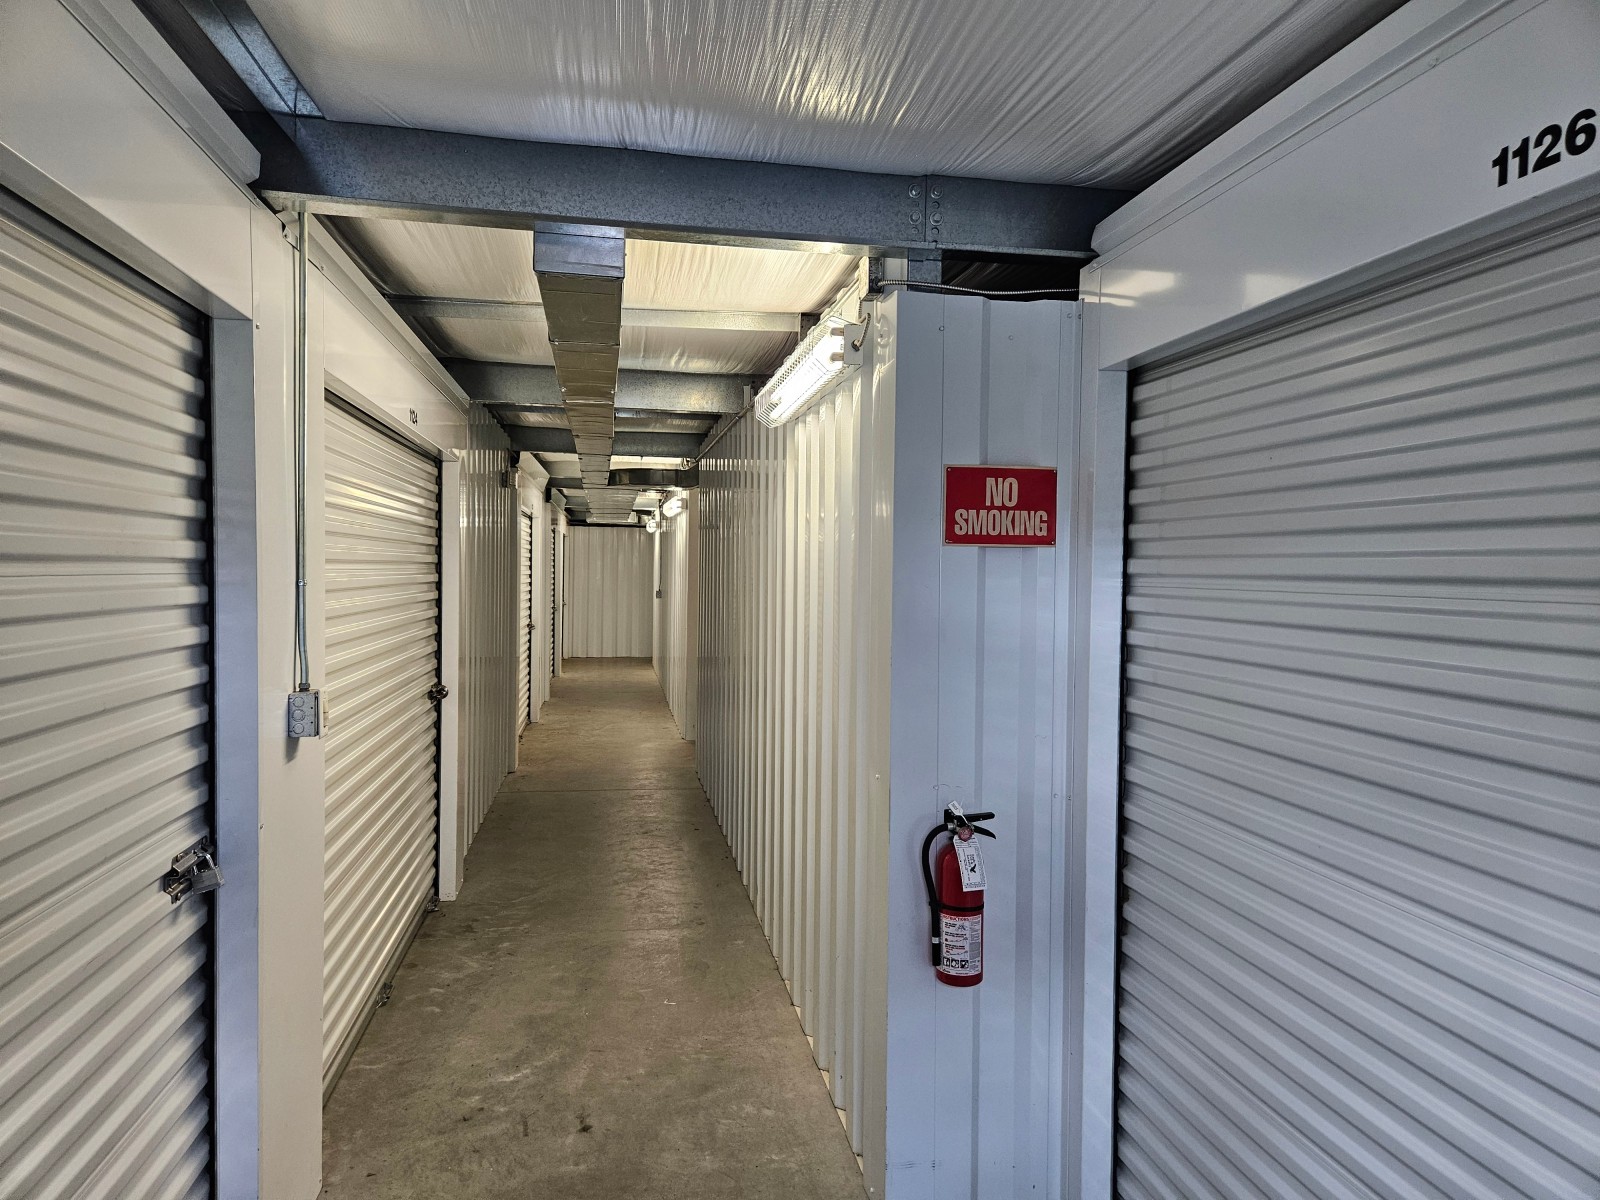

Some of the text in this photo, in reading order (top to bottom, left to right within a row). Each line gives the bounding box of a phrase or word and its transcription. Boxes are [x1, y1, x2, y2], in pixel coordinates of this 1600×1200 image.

[1491, 108, 1597, 187] 1126
[409, 407, 418, 426] 1124
[985, 477, 1018, 507] NO
[954, 508, 1048, 536] SMOKING
